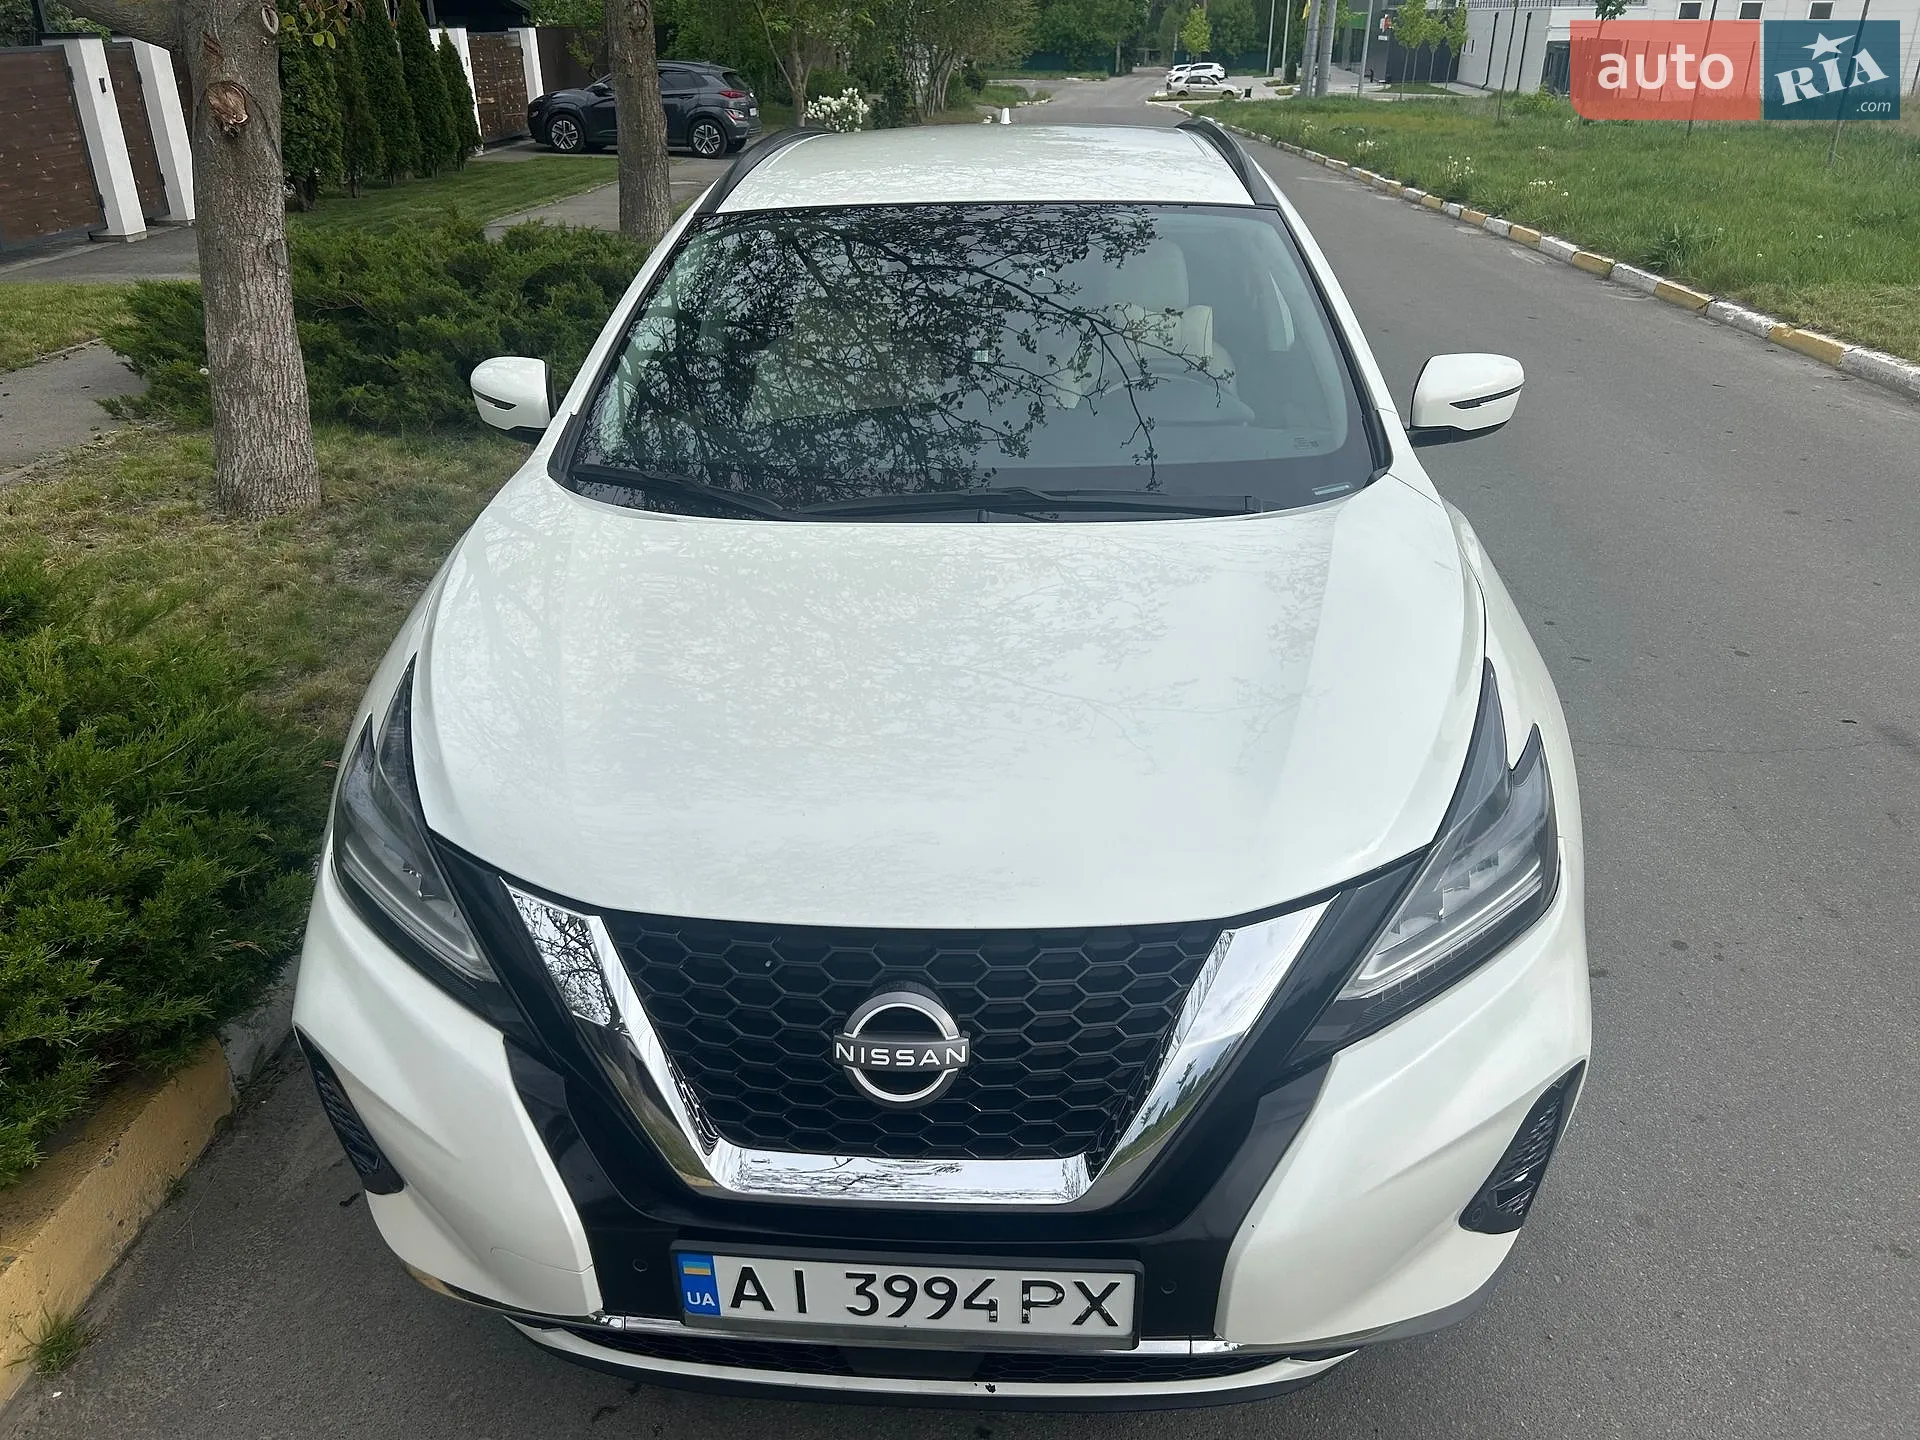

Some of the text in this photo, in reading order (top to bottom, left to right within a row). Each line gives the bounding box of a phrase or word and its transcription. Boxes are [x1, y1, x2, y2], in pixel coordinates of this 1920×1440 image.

[835, 1042, 967, 1067] NISSAN
[686, 1291, 716, 1307] UA
[729, 1266, 1121, 1327] AI 3994 PX
